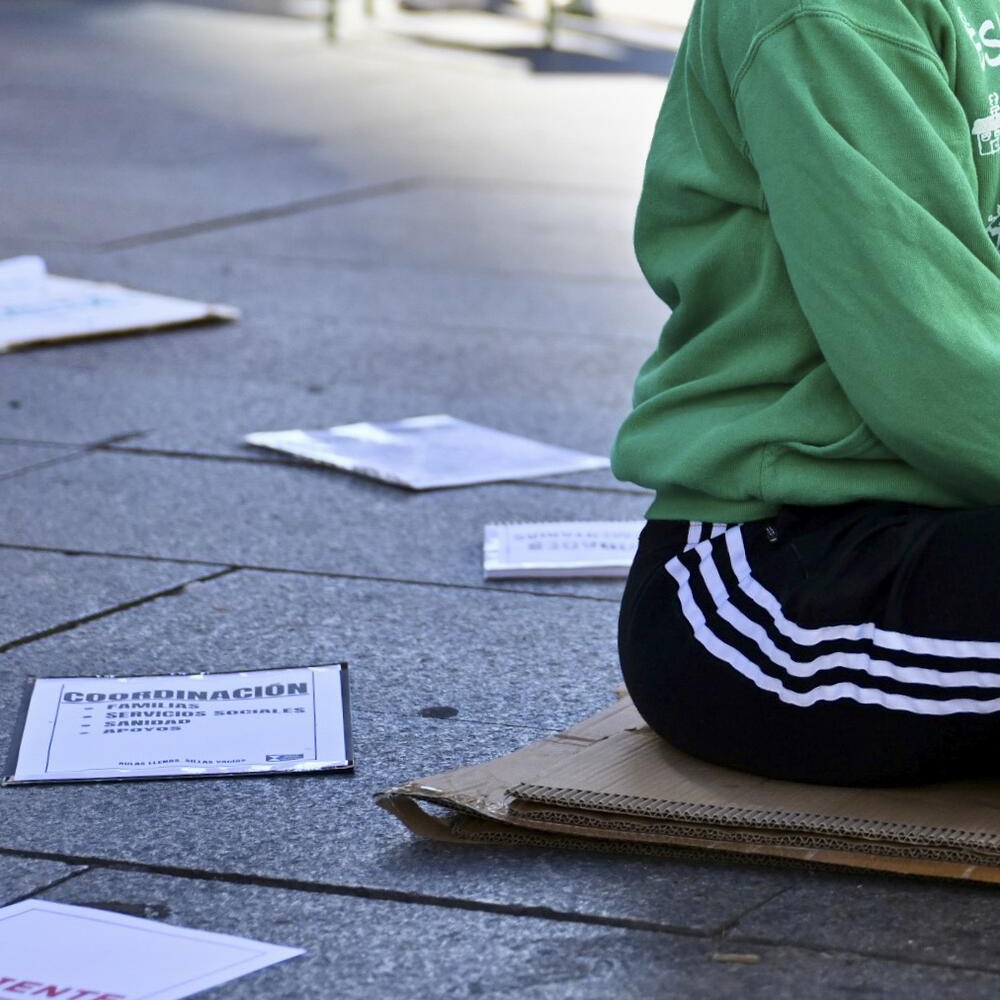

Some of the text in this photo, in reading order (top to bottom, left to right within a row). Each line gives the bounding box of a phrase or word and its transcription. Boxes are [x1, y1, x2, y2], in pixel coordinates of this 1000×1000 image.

[63, 682, 308, 703] COORDINACIÓN
[106, 702, 200, 710] FAMILIAS
[105, 707, 306, 719] SERVICIOS SOCIALES
[104, 719, 192, 728] SANIDAD
[103, 726, 182, 735] APOYOS
